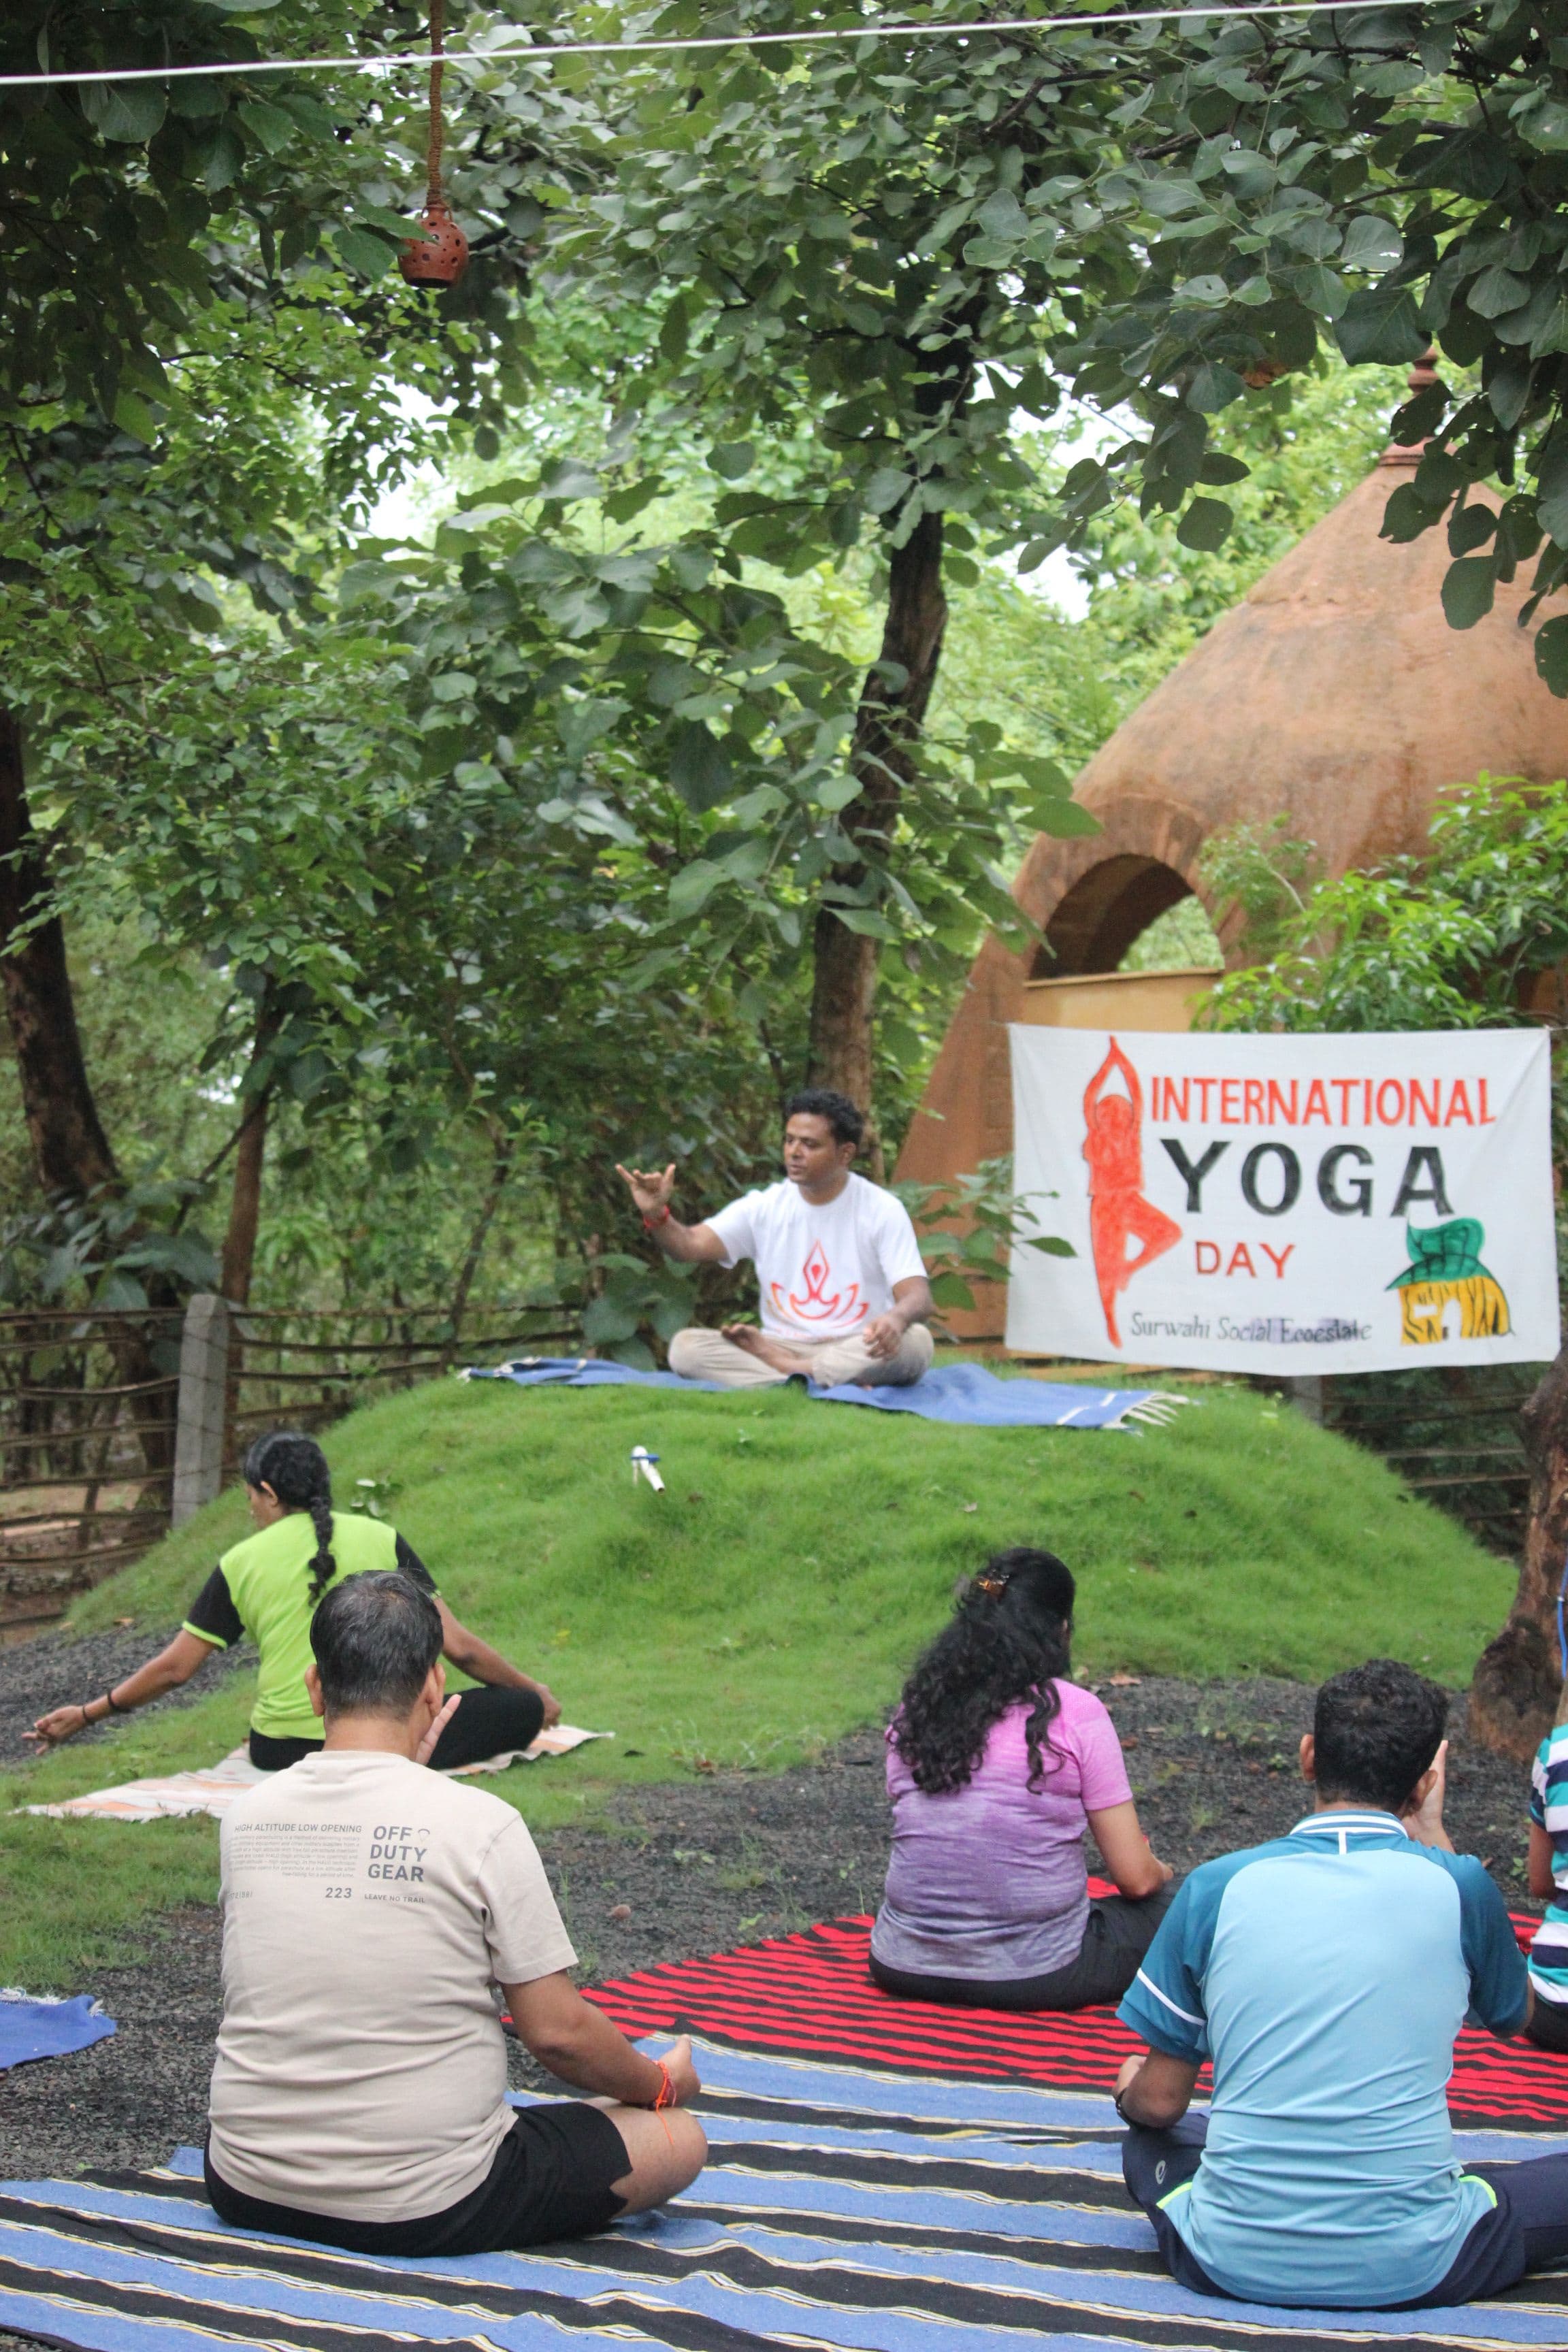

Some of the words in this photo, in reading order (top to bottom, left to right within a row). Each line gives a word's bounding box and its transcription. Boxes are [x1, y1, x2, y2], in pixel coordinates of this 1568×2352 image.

[1151, 1075, 1497, 1128] INTERNATIONAL
[1160, 1138, 1454, 1218] YOGA
[1196, 1241, 1296, 1279] DAY
[1131, 1312, 1210, 1339] Surwahi
[1218, 1316, 1271, 1342] Social
[255, 1823, 297, 1832] ALTITUDE
[298, 1824, 318, 1832] LOW
[321, 1824, 362, 1833] OPENING
[373, 1825, 413, 1841] OFF
[370, 1844, 427, 1862] DUTY
[368, 1863, 424, 1882] GEAR
[325, 1887, 353, 1899] 223
